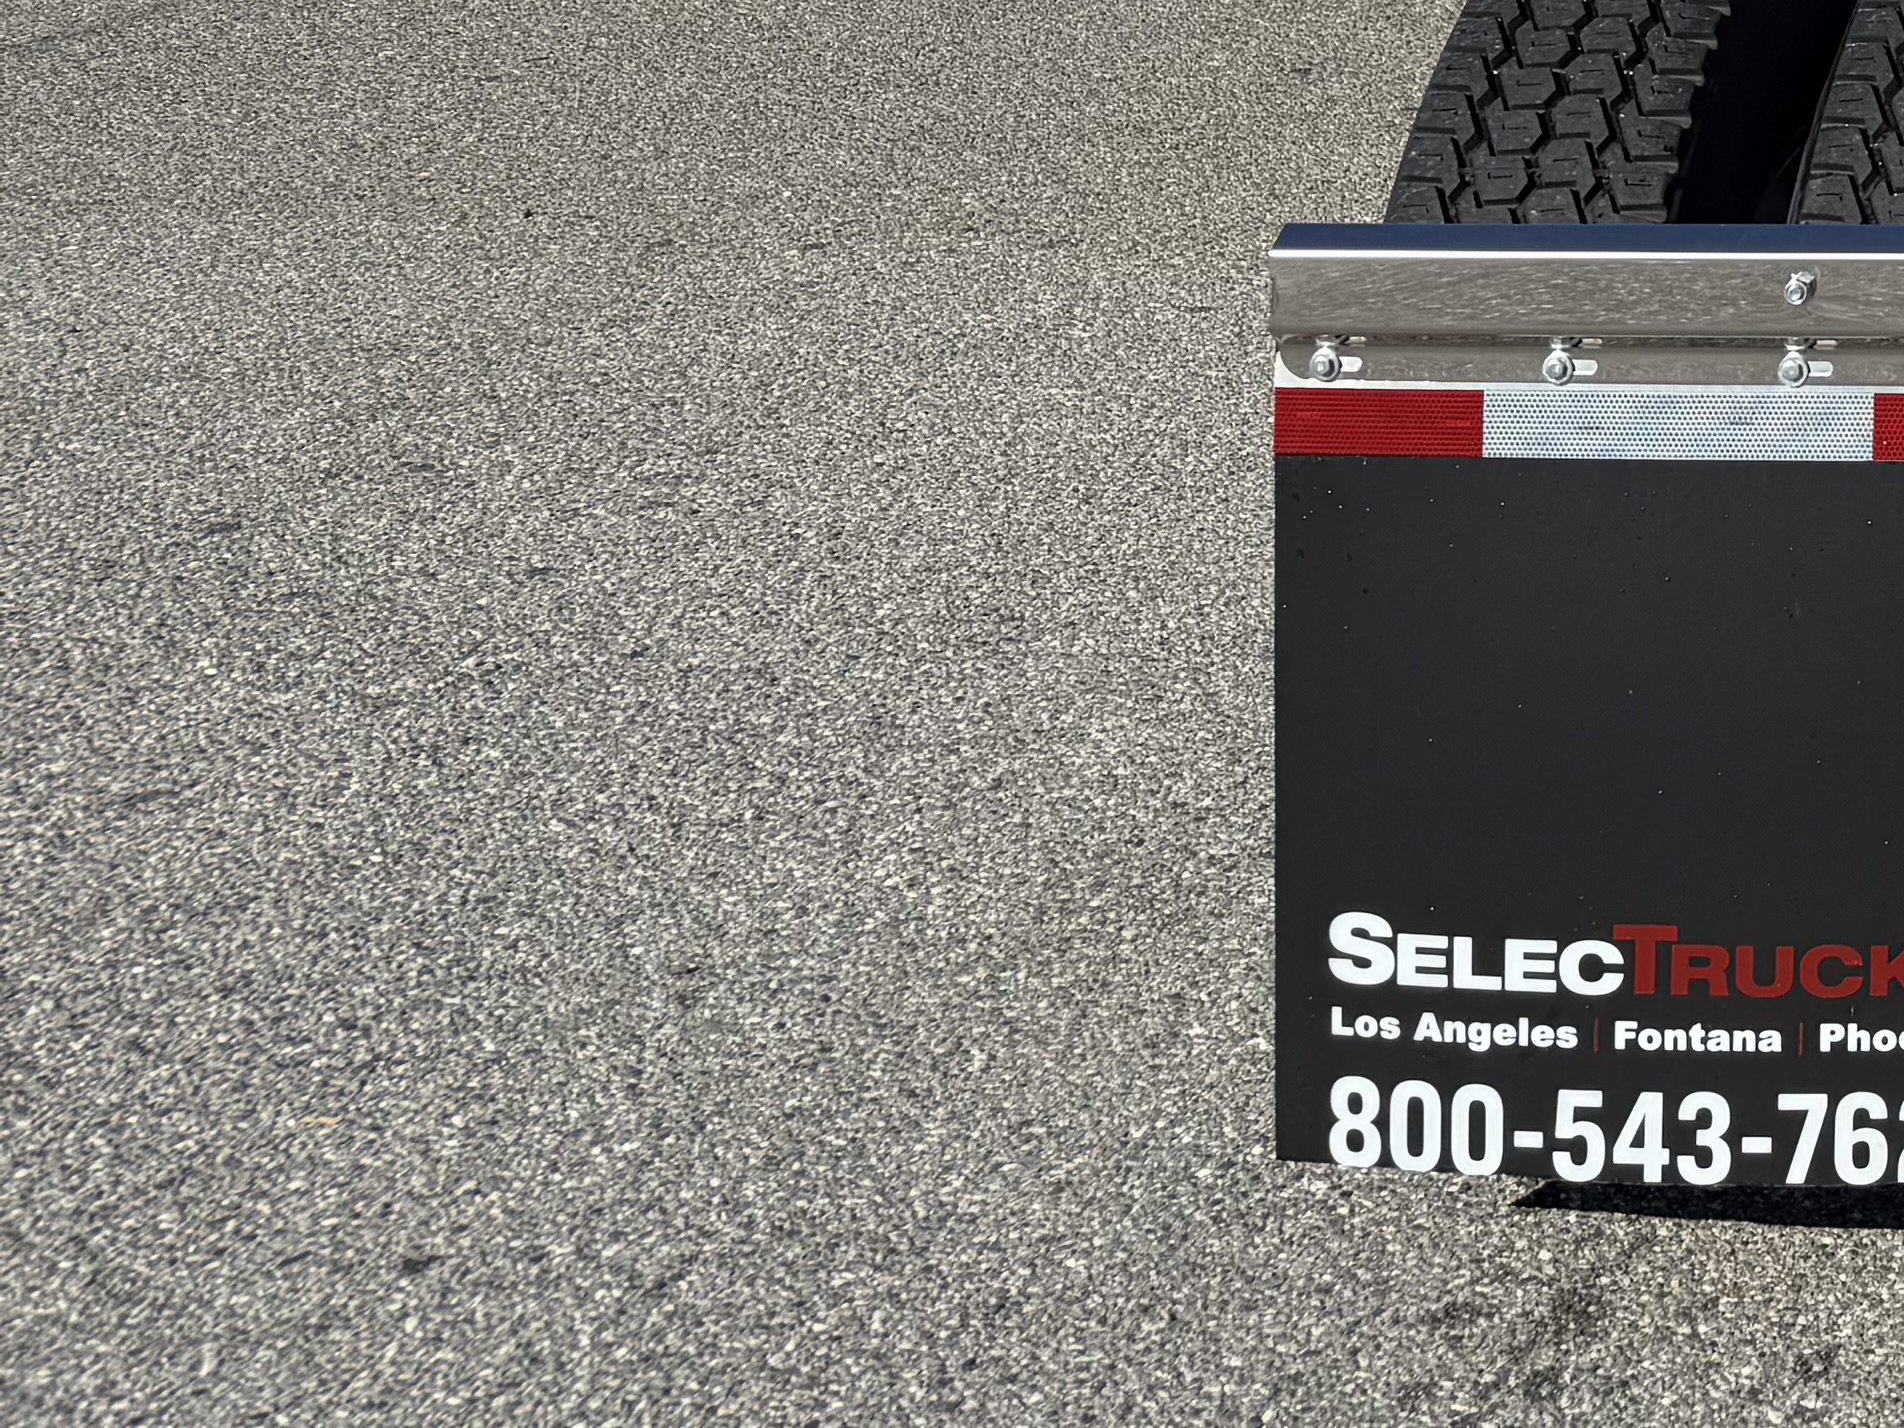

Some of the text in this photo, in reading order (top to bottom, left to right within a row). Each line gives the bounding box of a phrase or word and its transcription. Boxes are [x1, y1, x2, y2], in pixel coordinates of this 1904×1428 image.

[1330, 1006, 1401, 1041] Los
[1413, 1011, 1579, 1052] Angeles
[1614, 1020, 1783, 1053] Fontana
